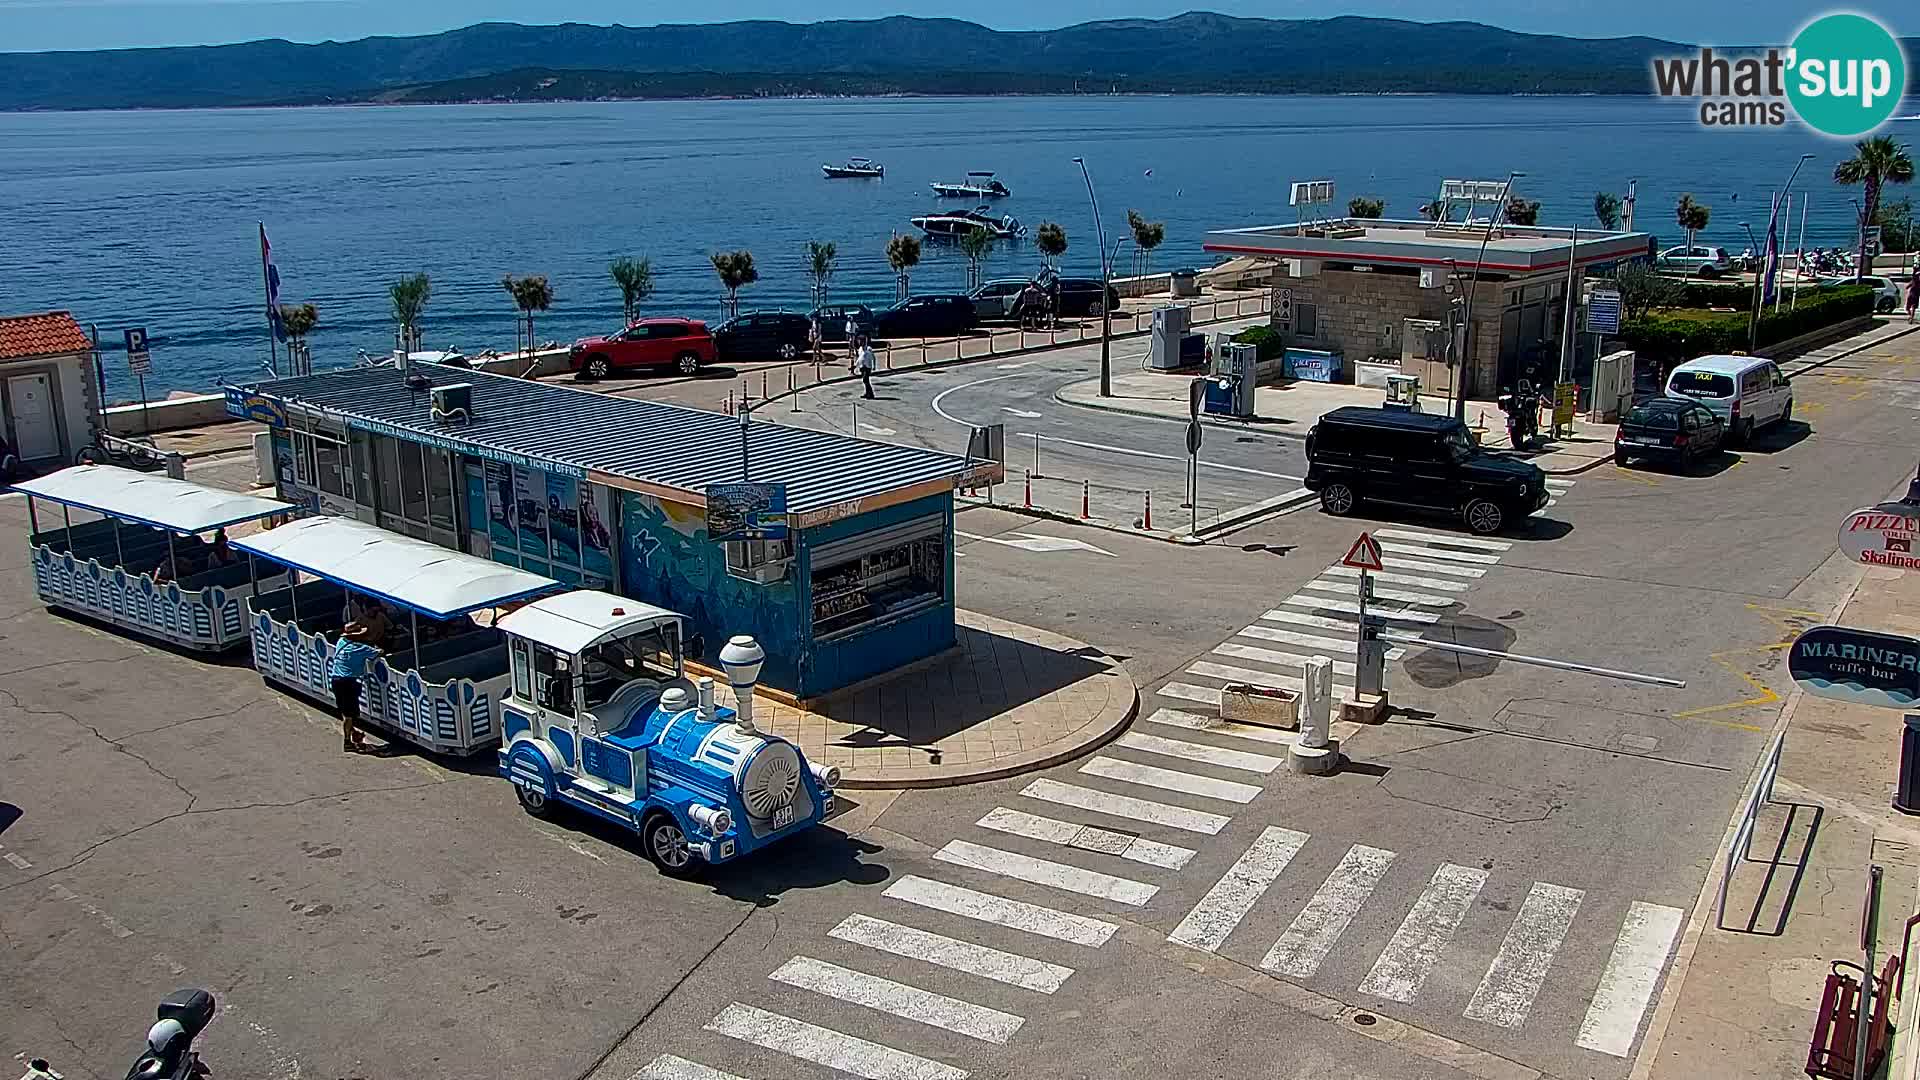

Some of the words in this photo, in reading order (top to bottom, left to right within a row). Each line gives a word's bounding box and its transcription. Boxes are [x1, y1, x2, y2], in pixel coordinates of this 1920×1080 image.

[130, 331, 142, 350] P
[1694, 371, 1713, 381] TAXI
[436, 437, 469, 452] POSTAJA
[478, 446, 493, 458] BUS
[493, 450, 526, 466] STATION
[528, 457, 554, 472] TICKET
[555, 463, 582, 478] OFFICE
[1848, 514, 1920, 534] PIZZE
[1800, 642, 1920, 673] MARINER
[1829, 662, 1866, 675] caffe
[1871, 665, 1897, 680] bar
